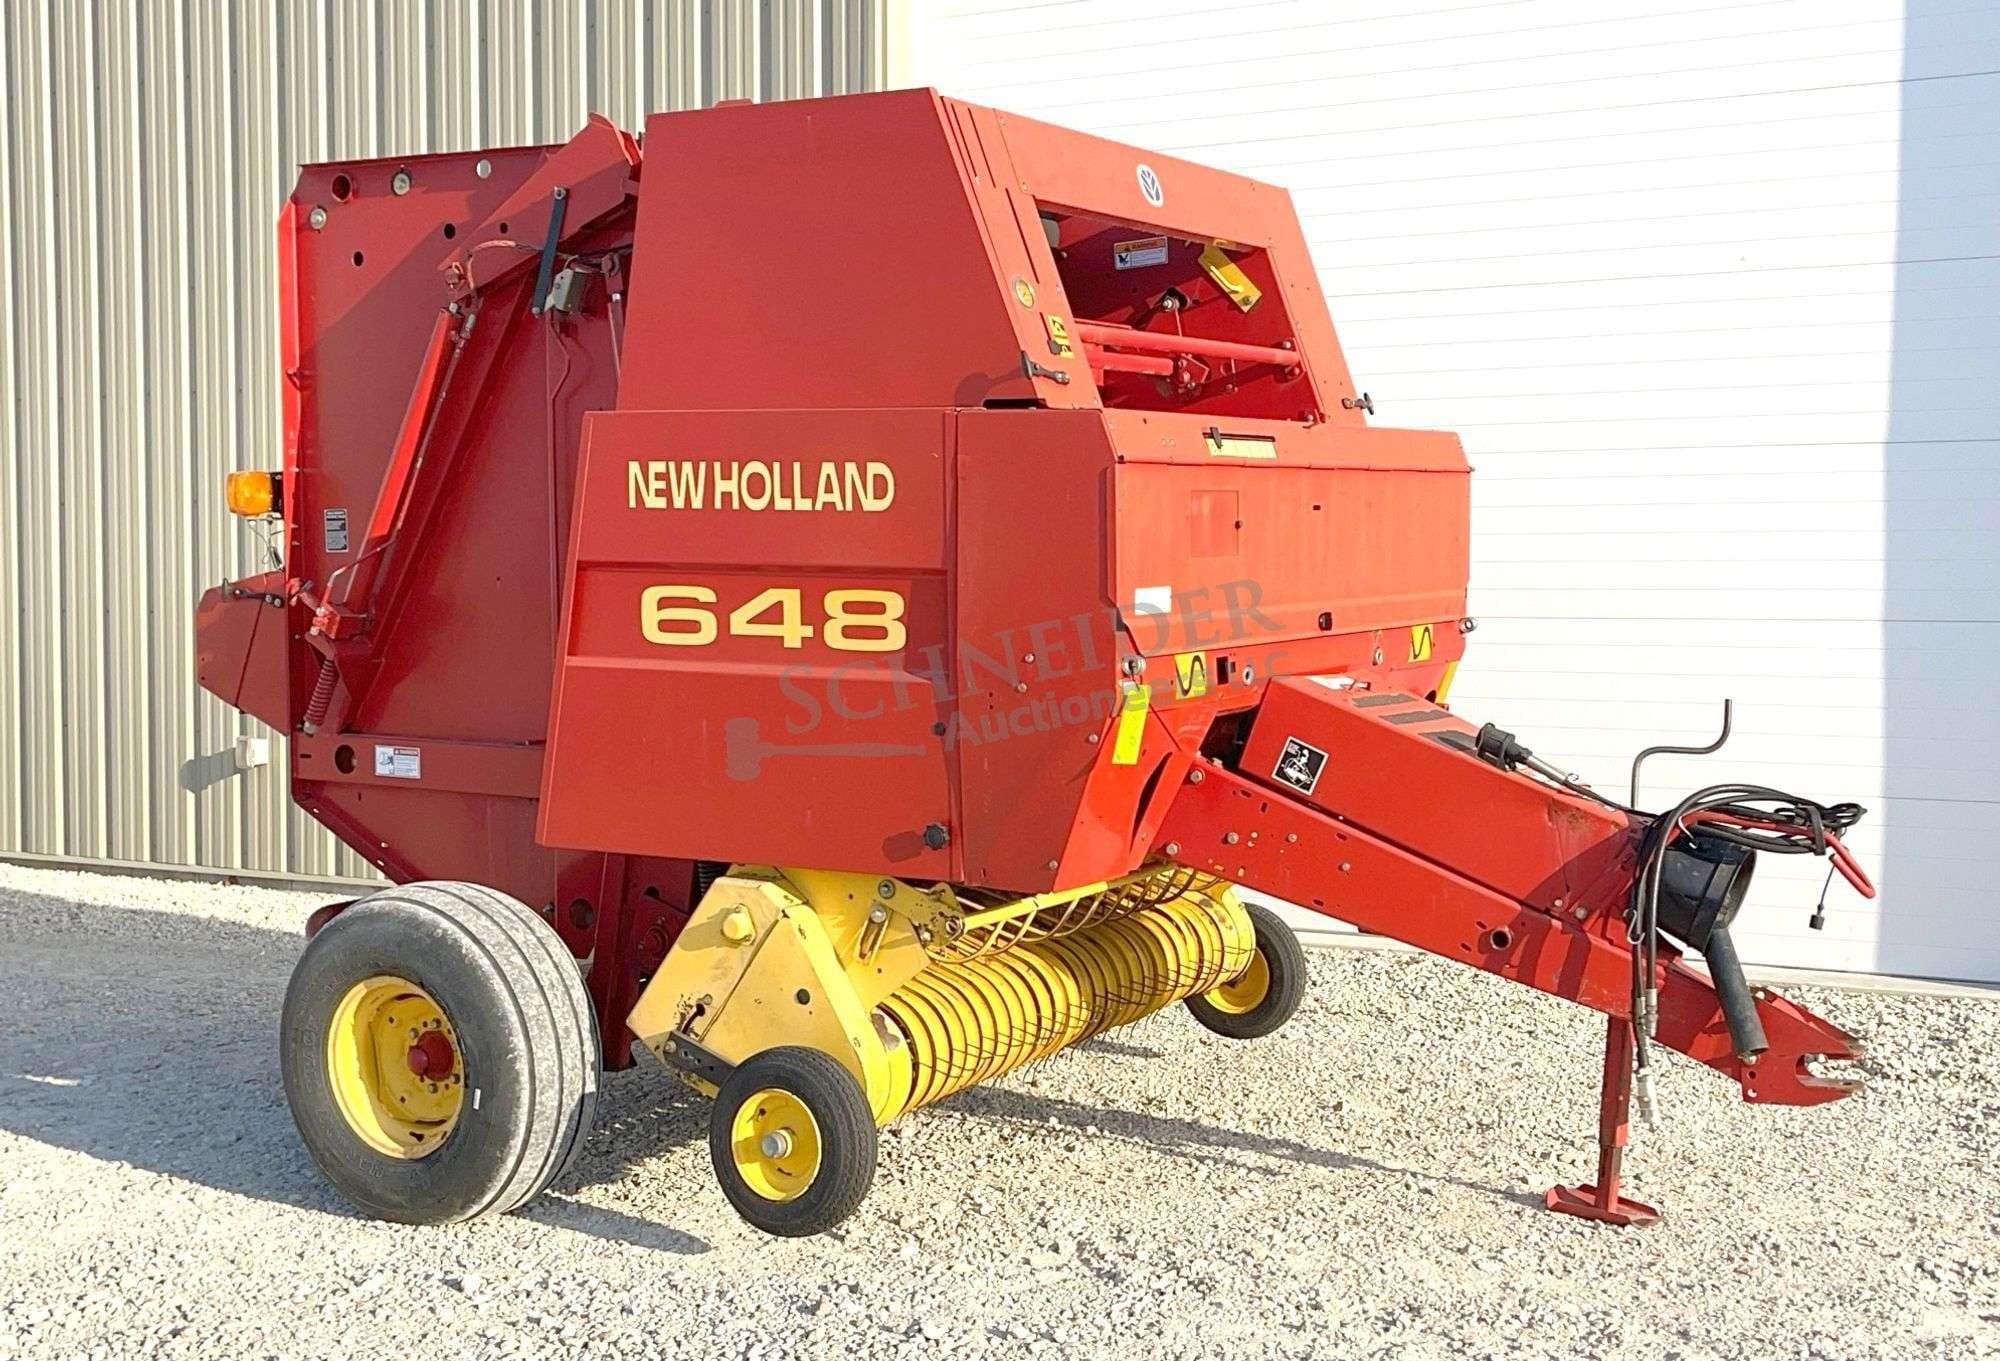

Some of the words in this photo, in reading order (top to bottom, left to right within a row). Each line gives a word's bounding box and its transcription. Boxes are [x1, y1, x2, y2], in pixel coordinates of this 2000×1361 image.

[627, 460, 706, 511] NEW
[713, 460, 896, 513] HOLLAND
[640, 584, 908, 653] 648
